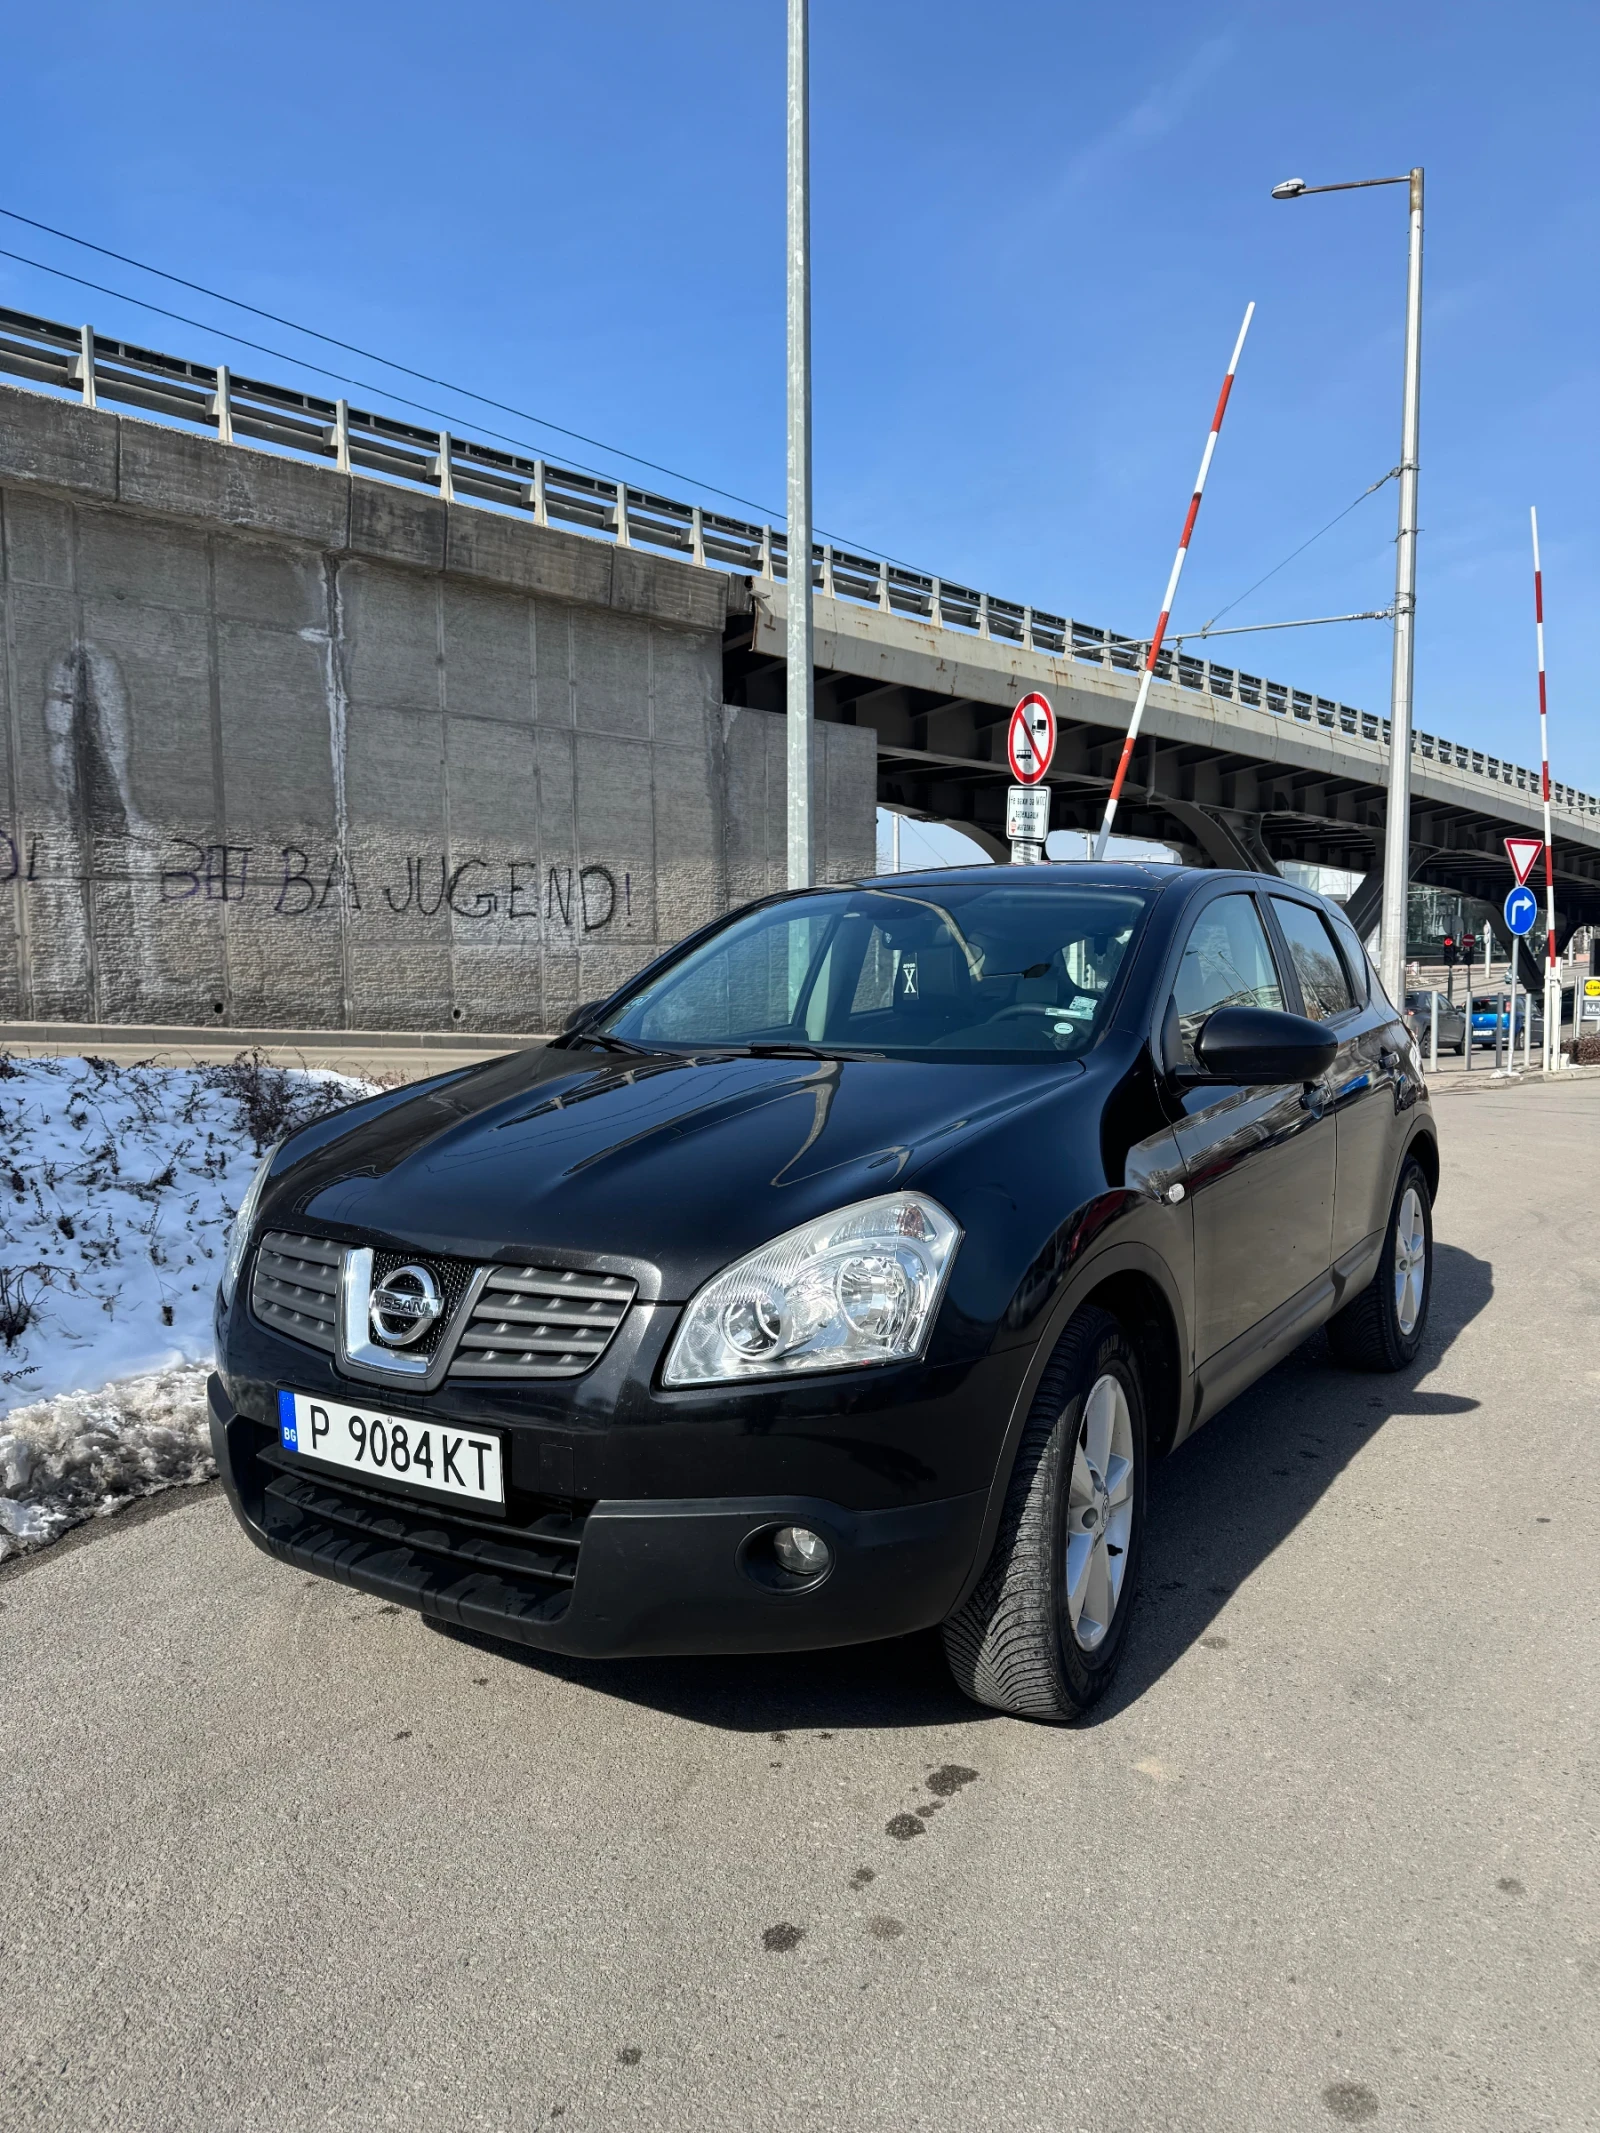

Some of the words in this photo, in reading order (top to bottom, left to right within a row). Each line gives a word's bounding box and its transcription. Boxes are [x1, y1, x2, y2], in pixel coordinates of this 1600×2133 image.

[374, 1294, 426, 1314] NISSAN
[283, 1427, 297, 1443] BG
[310, 1404, 330, 1450] P
